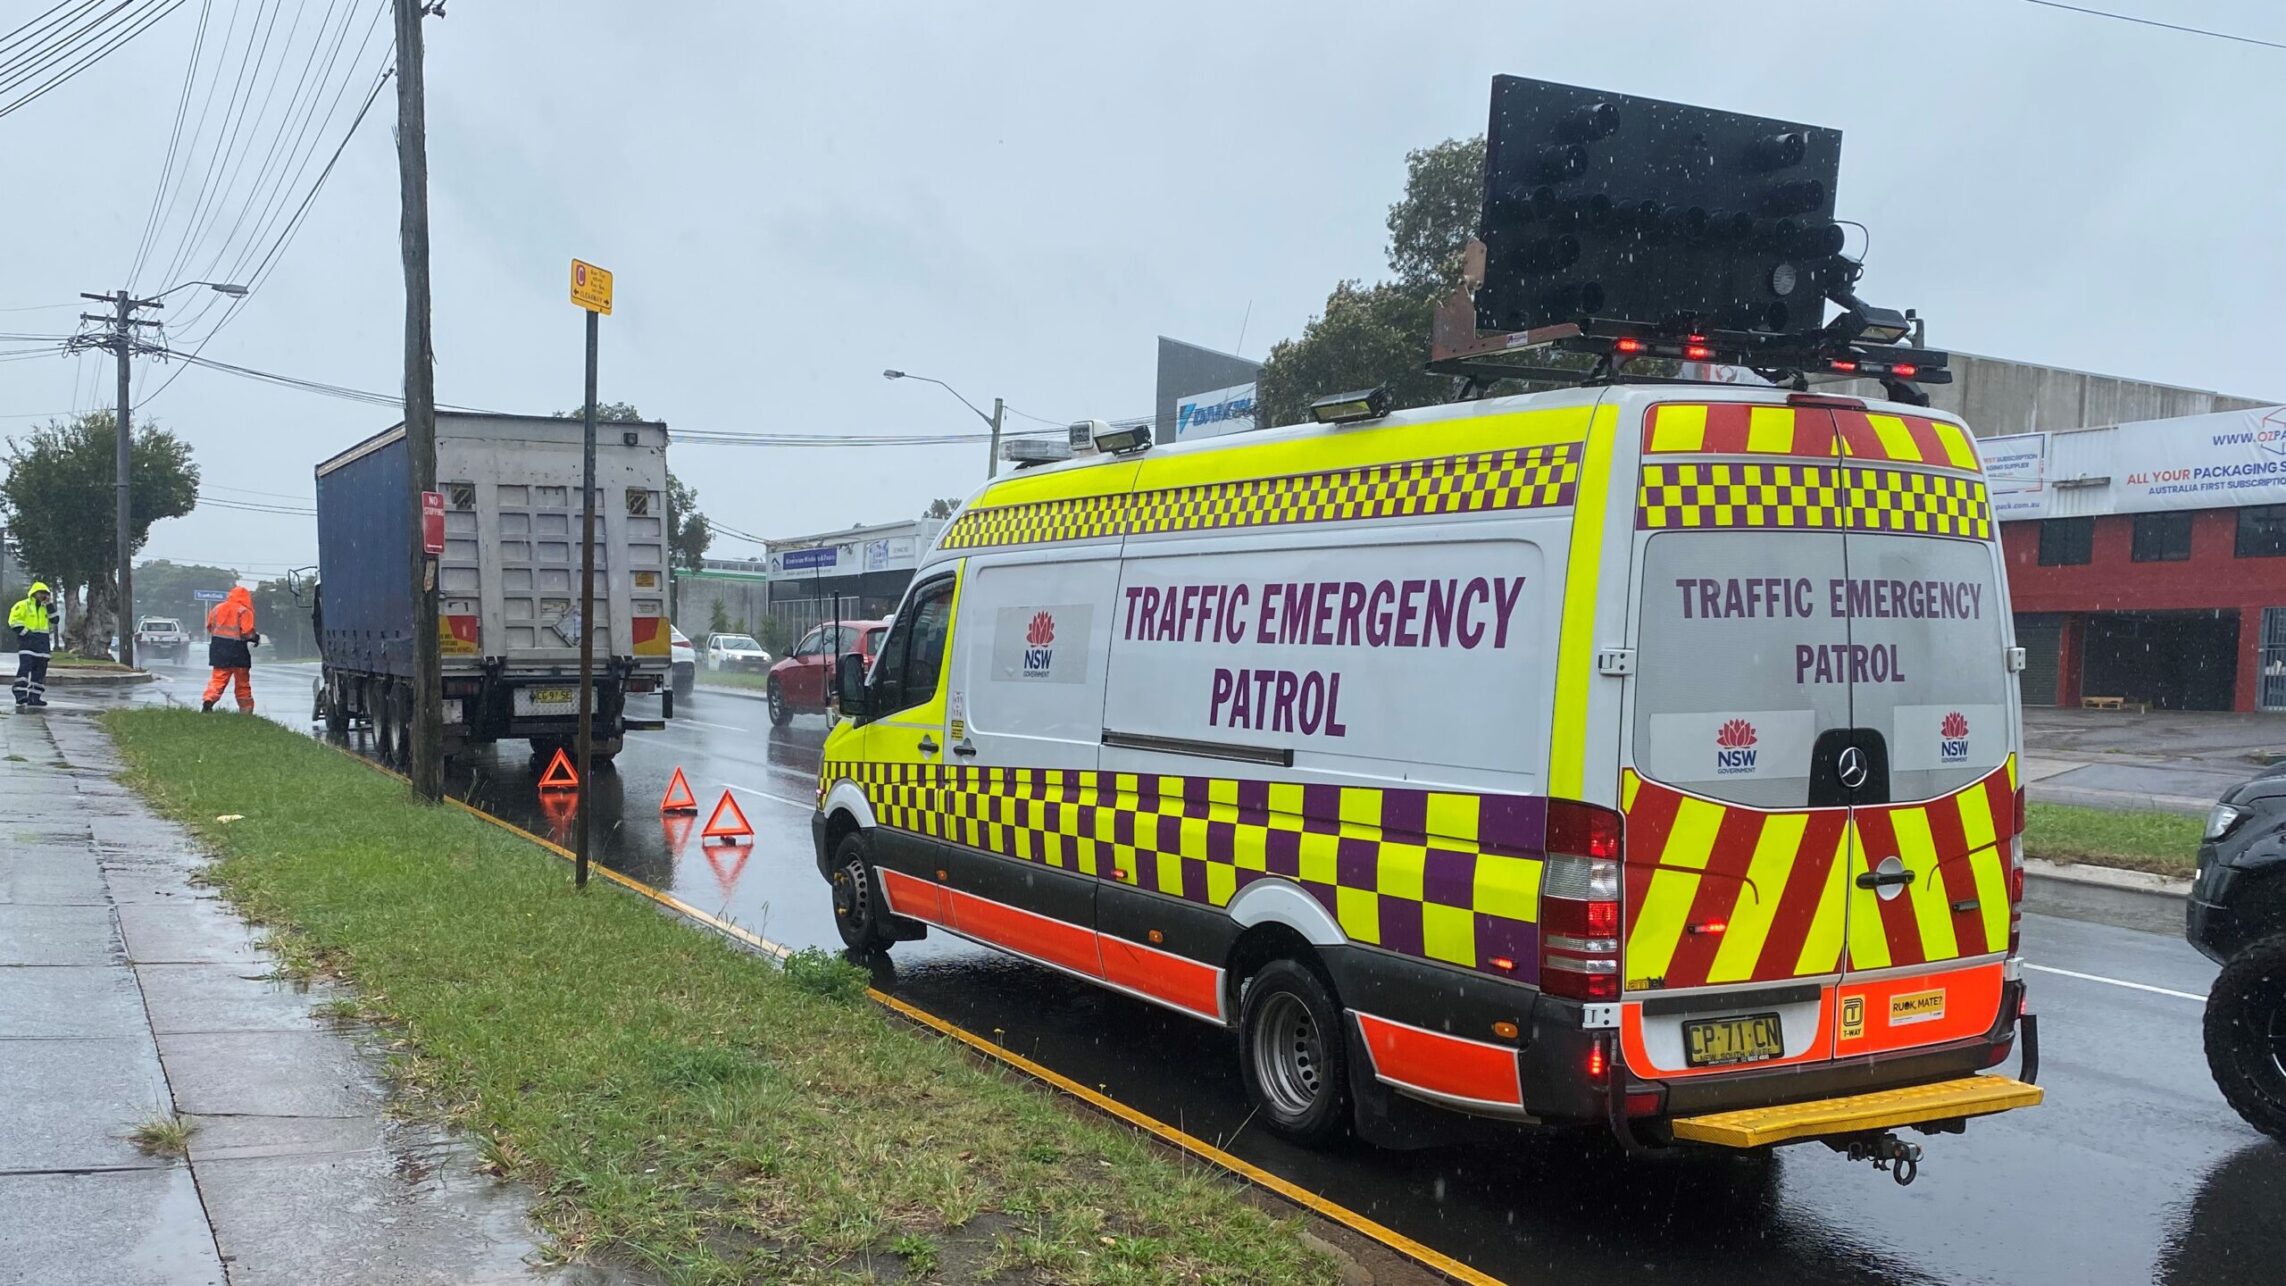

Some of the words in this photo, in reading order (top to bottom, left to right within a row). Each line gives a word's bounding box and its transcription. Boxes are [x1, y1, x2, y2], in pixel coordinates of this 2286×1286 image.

[2127, 474, 2149, 485] ALL
[2153, 469, 2190, 483] YOUR
[2193, 461, 2278, 480] PACKAGING
[2149, 483, 2198, 495] AUSTRALIA
[2201, 481, 2226, 491] FIRST
[429, 496, 438, 506] NO
[1676, 578, 1813, 619] TRAFFIC
[1829, 579, 1981, 619] EMERGENCY
[1124, 583, 1249, 644] TRAFFIC
[1256, 577, 1526, 649] EMERGENCY
[1024, 649, 1053, 669] NSW
[1796, 643, 1905, 684] PATROL
[1209, 668, 1347, 737] PATROL
[1942, 741, 1968, 756] NSW
[1718, 750, 1757, 767] NSW
[1918, 996, 1943, 1008] MATE?
[1843, 1028, 1861, 1038] T-WAY
